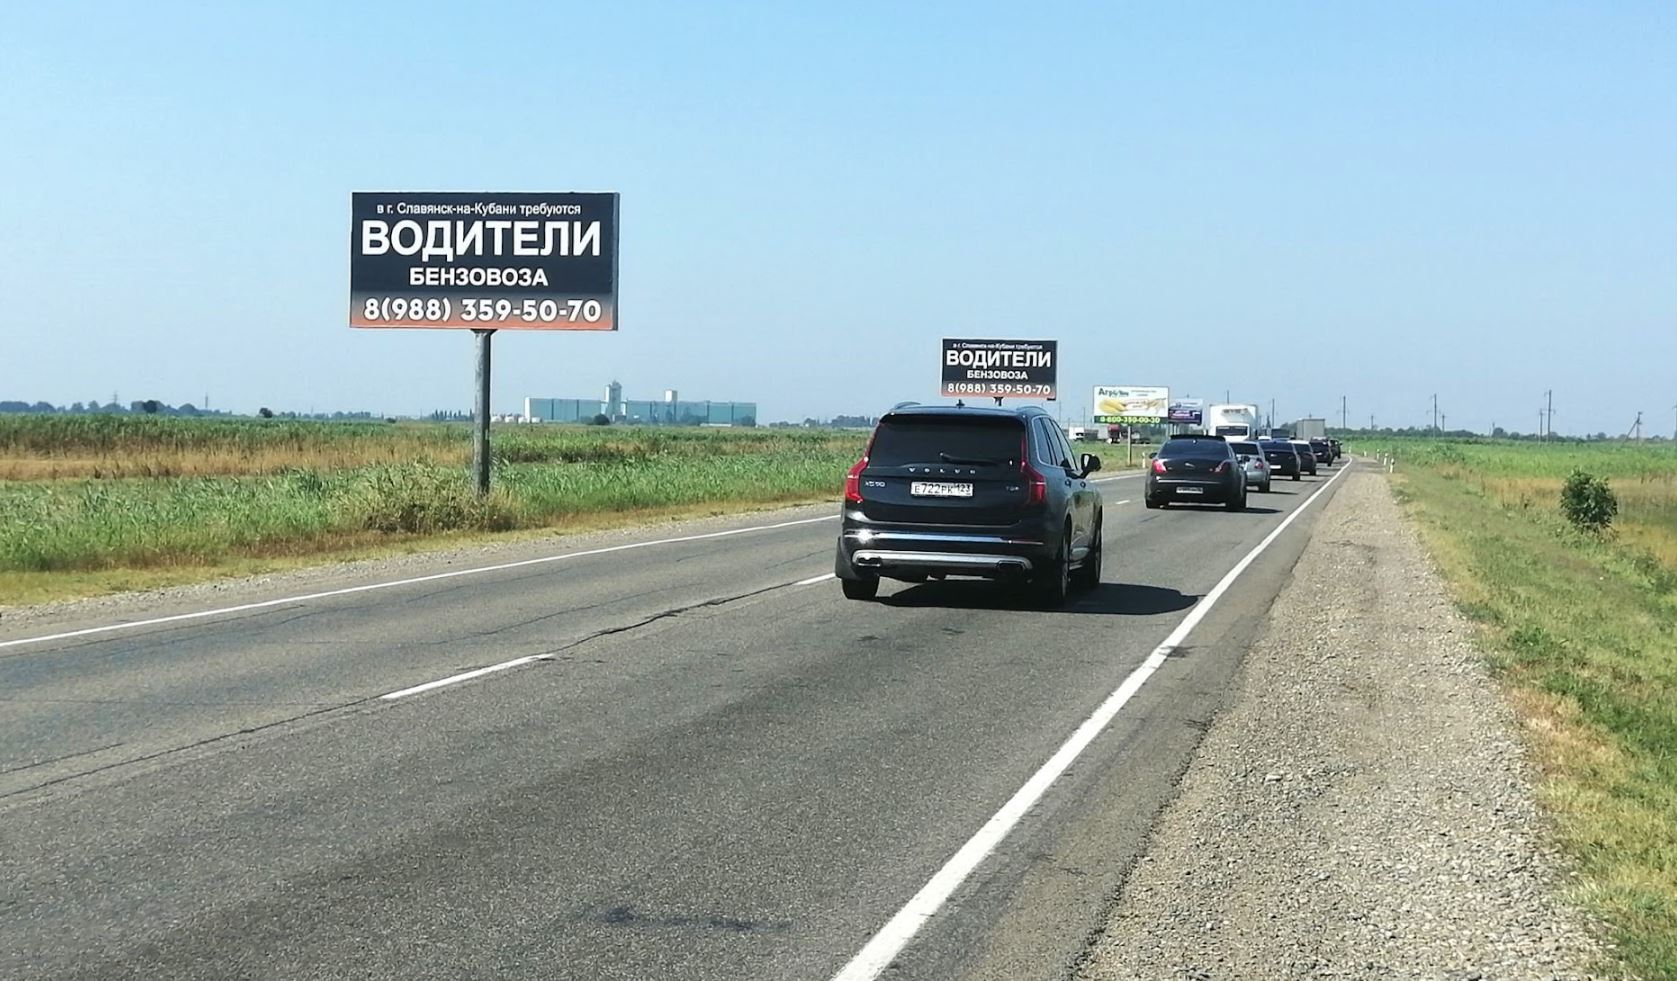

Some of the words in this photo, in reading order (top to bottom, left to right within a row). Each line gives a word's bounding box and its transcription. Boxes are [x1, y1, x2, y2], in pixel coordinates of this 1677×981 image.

[377, 205, 384, 214] в
[387, 205, 394, 214] г.
[396, 202, 517, 217] Славянск-на-Кубани
[519, 204, 581, 217] требуются
[361, 220, 601, 262] ВОДИТЕЛИ
[409, 267, 549, 286] БЕНЗОВОЗА
[363, 297, 452, 322] 8(988)
[460, 298, 602, 323] 359-50-70
[946, 350, 1051, 369] ВОДИТЕЛИ
[967, 370, 1028, 380] БЕНЗОВОЗА
[947, 383, 986, 394] 8(988)
[990, 384, 1051, 395] 359-50-70
